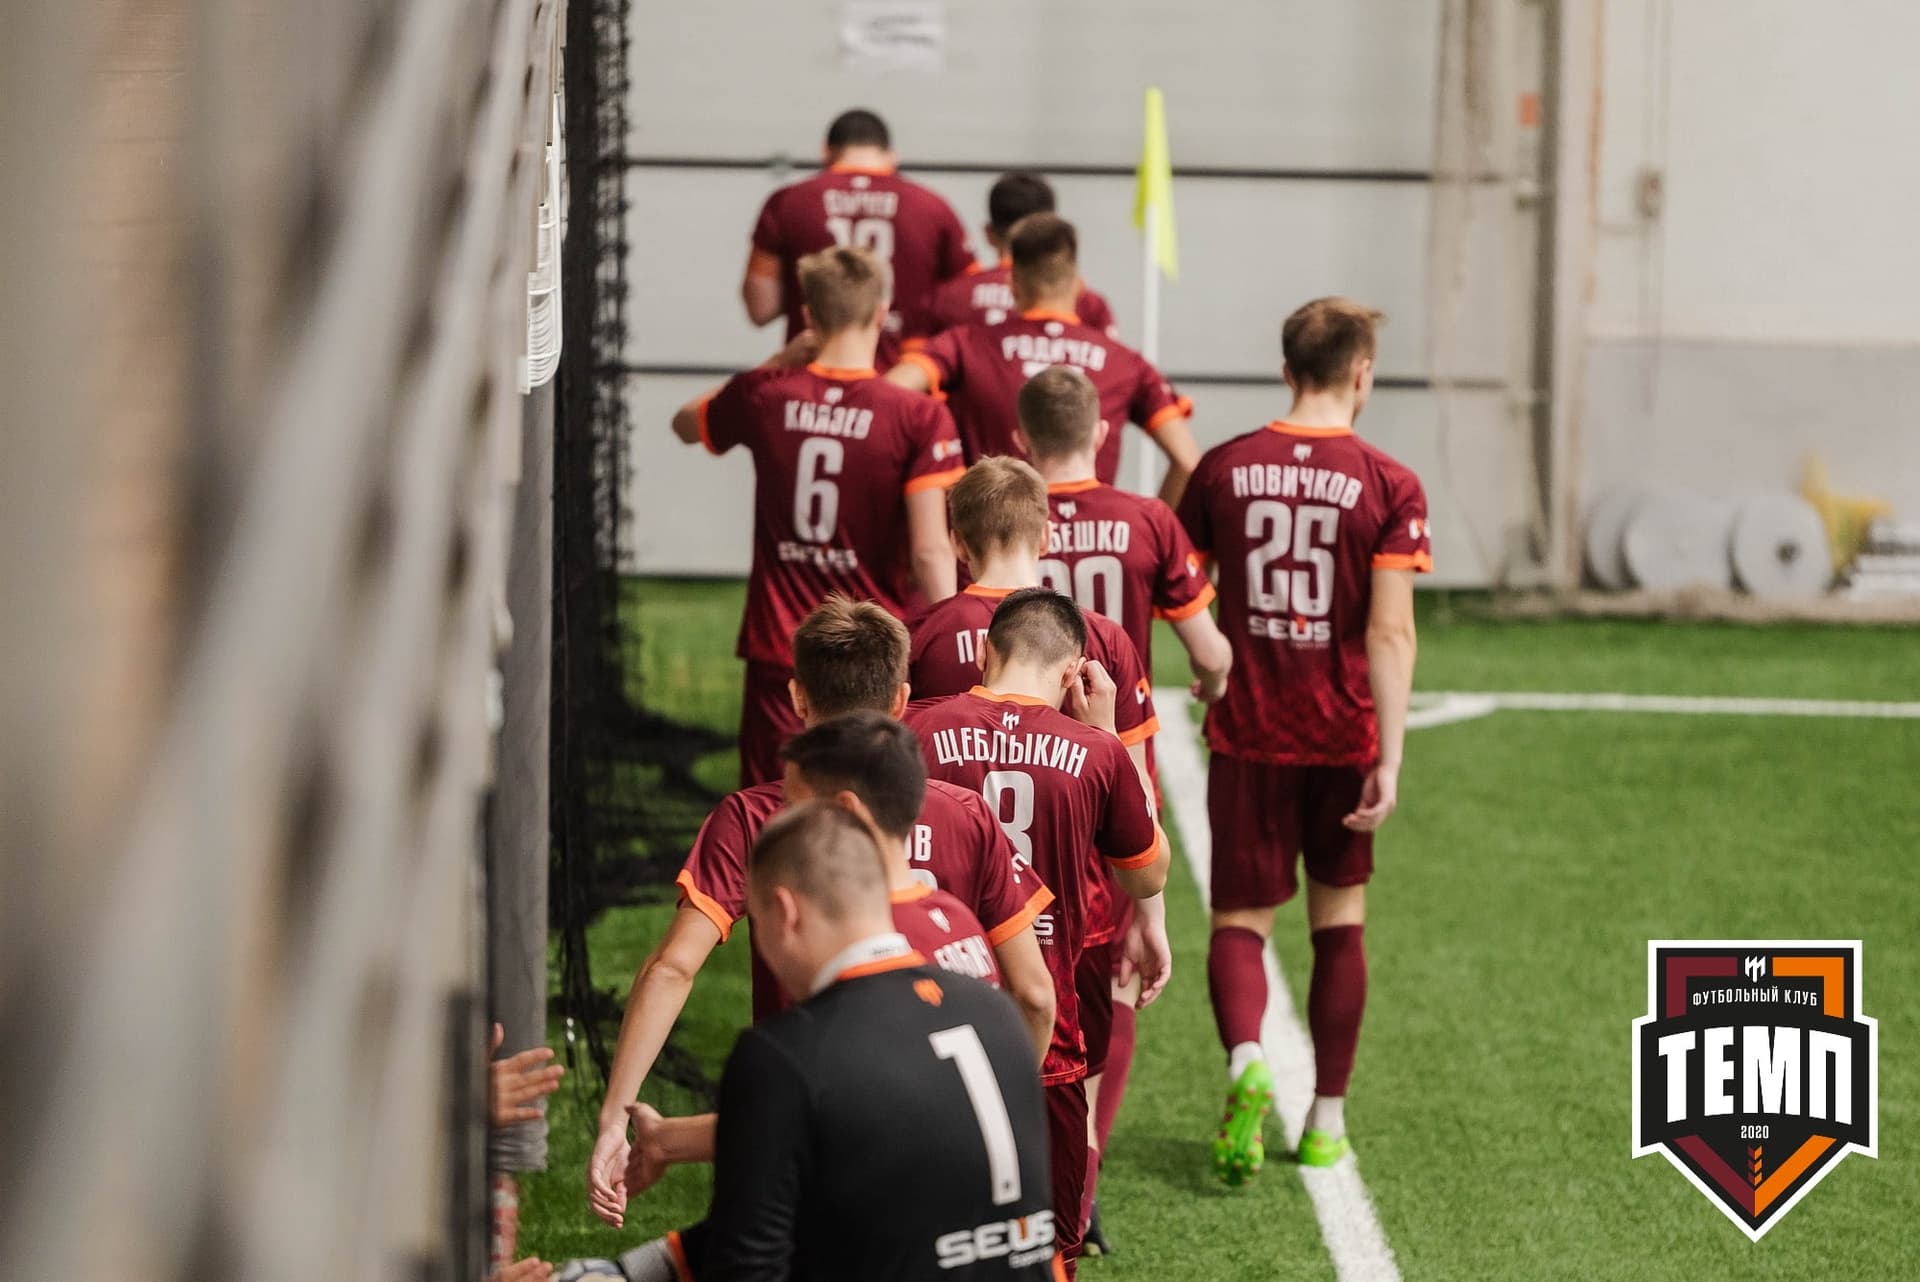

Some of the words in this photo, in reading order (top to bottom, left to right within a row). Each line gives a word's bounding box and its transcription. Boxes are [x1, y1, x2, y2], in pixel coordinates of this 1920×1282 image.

[794, 436, 845, 542] 6
[1232, 463, 1363, 510] НОВИЧКОВ
[1245, 500, 1340, 617] 25
[1248, 614, 1331, 642] SEUS
[933, 727, 1088, 778] ЩЕБЛЫКИН
[928, 1023, 1021, 1206] 1
[934, 1209, 1056, 1270] SEUS
